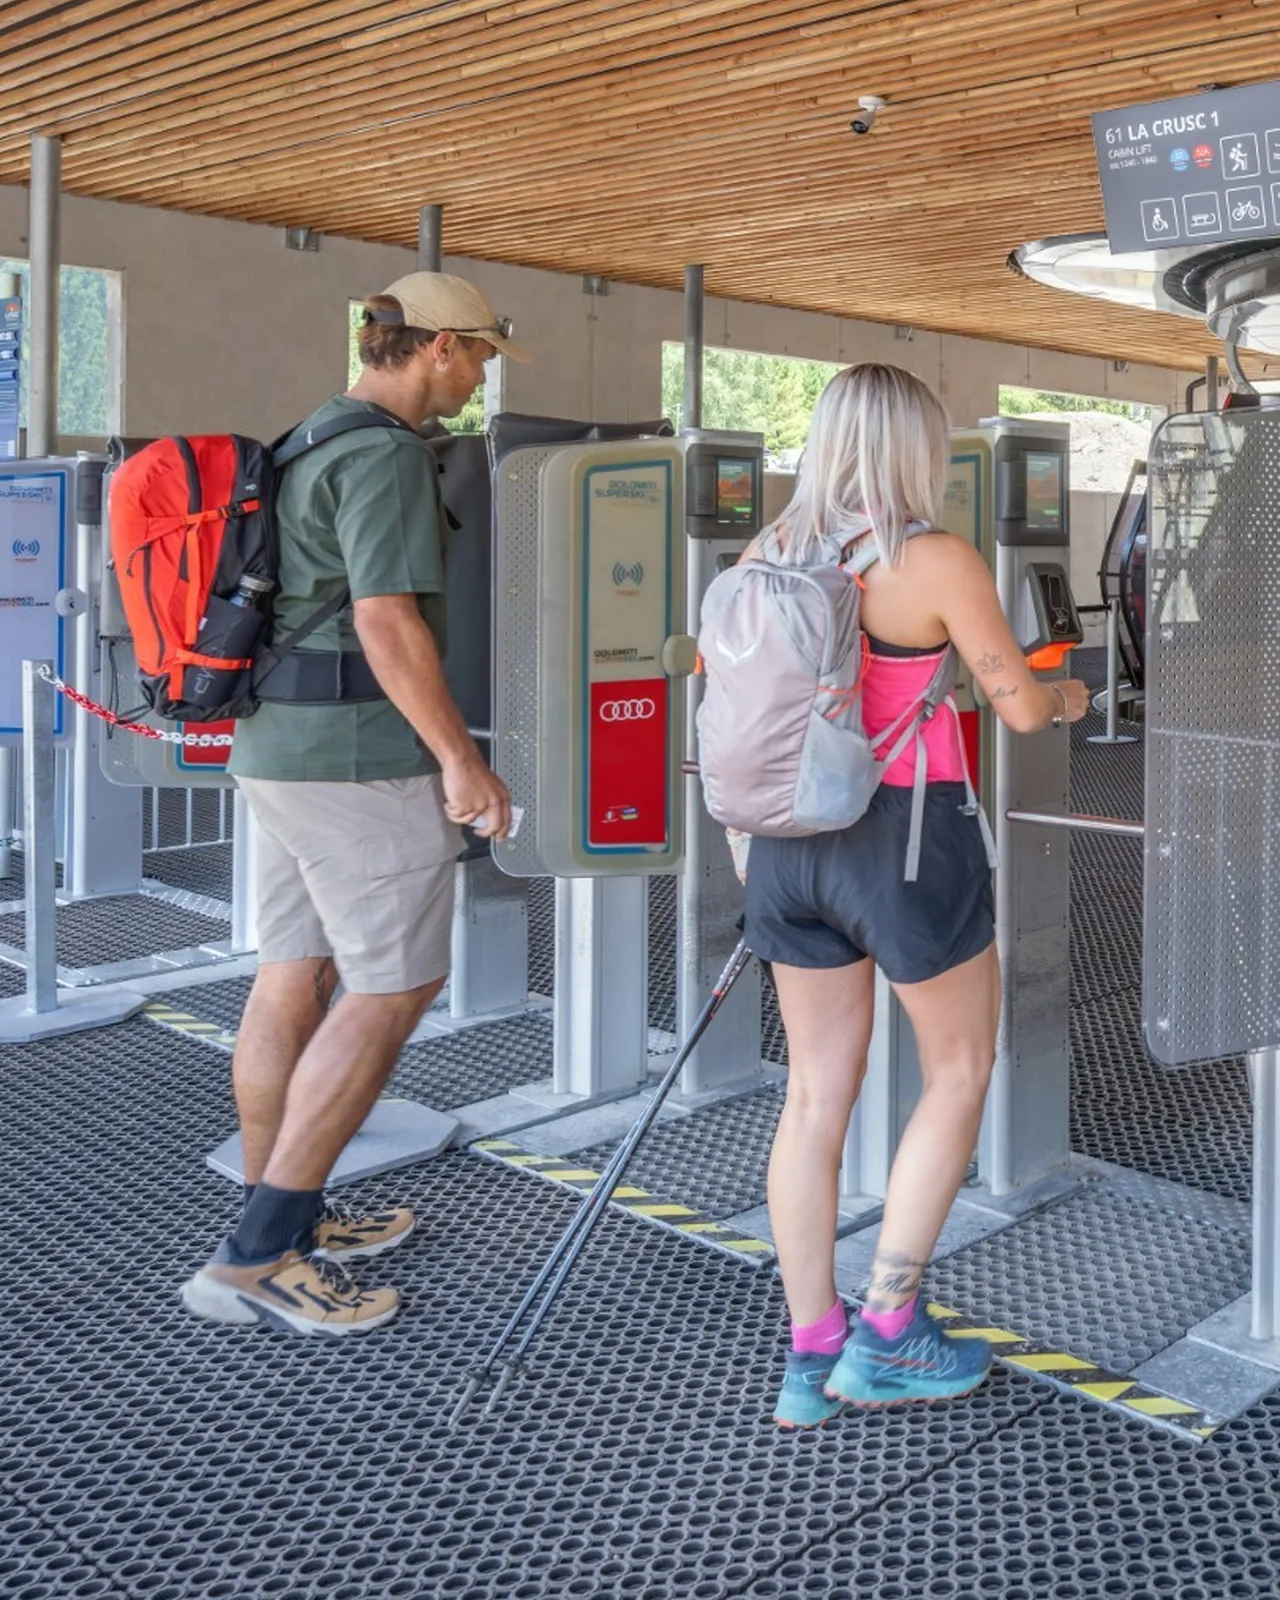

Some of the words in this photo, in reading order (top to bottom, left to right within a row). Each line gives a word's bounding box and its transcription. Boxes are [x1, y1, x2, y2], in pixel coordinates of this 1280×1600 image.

[1105, 128, 1122, 144] 61
[1128, 123, 1149, 141] LA
[1152, 113, 1206, 136] CRUSC
[1210, 110, 1219, 127] 1
[1108, 146, 1134, 160] CABIN
[1135, 143, 1152, 155] LIFT
